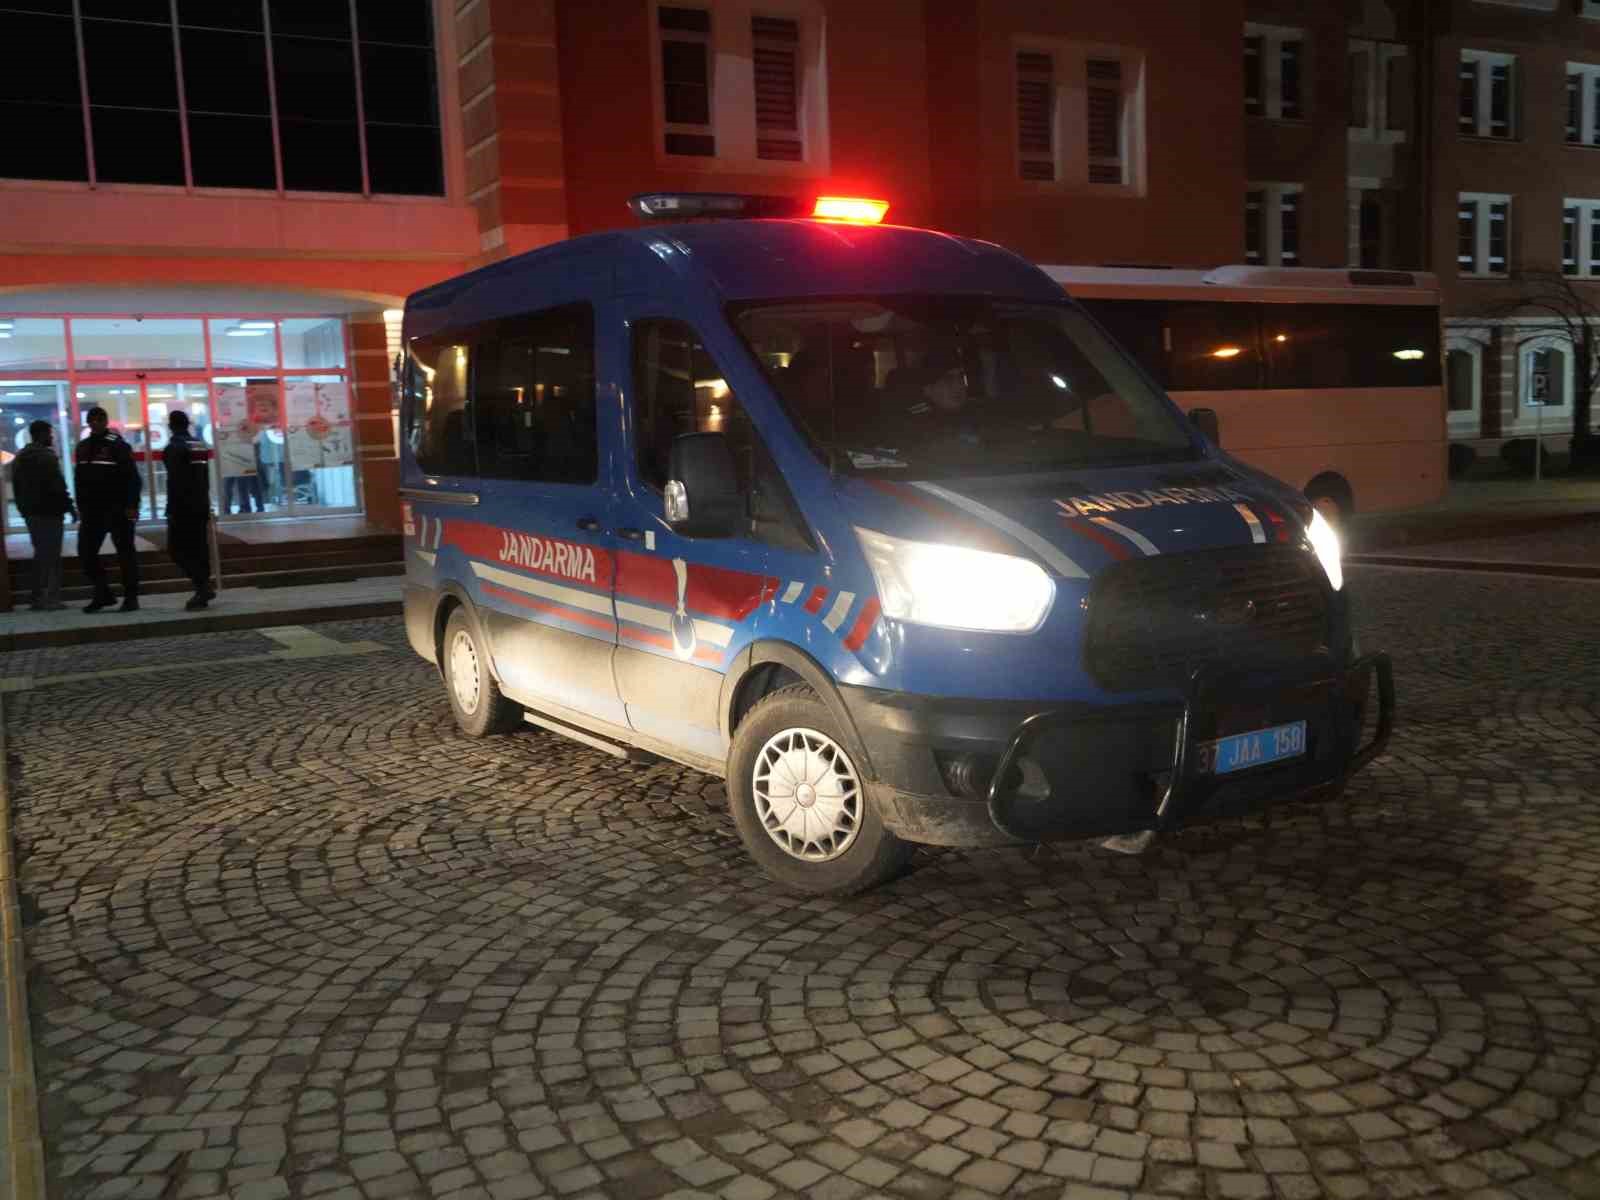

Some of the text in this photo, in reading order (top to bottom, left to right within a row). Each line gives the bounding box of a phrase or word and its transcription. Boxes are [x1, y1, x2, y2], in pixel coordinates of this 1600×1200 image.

[1054, 488, 1249, 517] JANDARMA
[498, 530, 596, 583] JANDARMA
[1229, 736, 1263, 764] JAA
